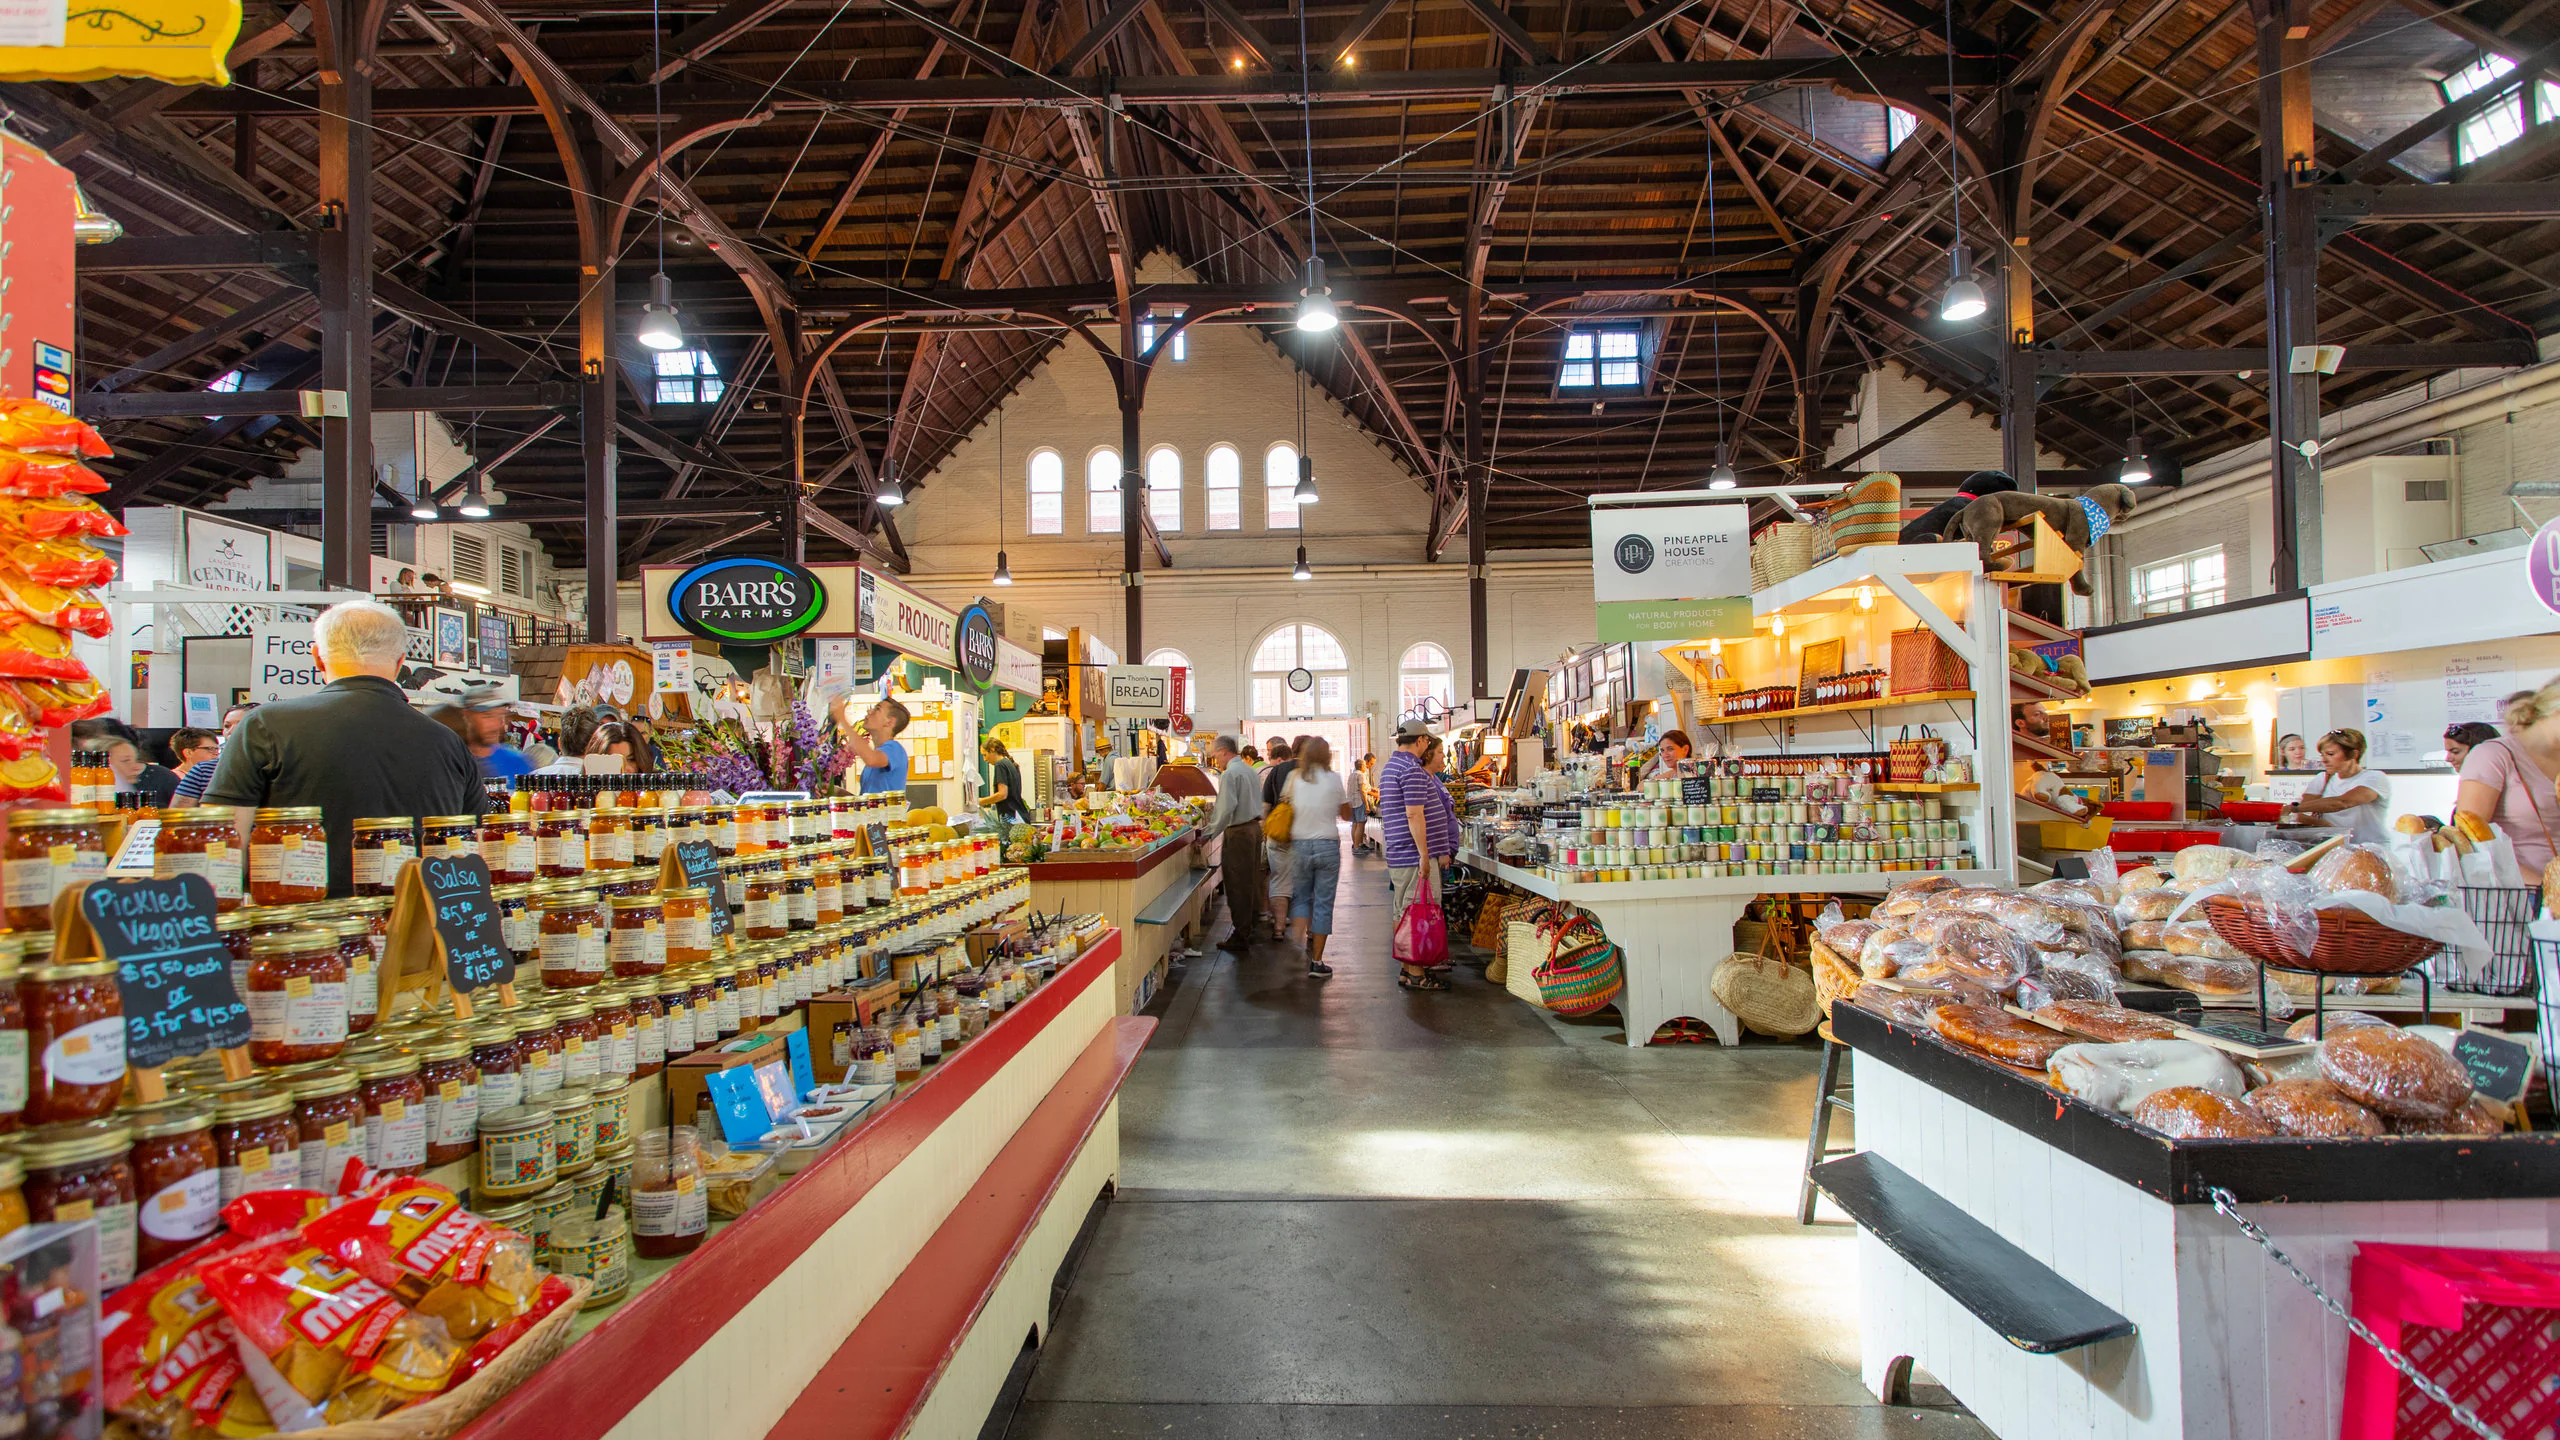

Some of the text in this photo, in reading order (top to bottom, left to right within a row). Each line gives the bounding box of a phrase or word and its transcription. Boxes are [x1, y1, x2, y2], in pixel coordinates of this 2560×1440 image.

[1664, 534, 1728, 545] PINEAPPLE
[1664, 547, 1705, 557] HOUSE
[208, 557, 252, 569] LANCASTER
[1665, 558, 1715, 567] CREATIONS
[193, 567, 262, 591] CENTRAL
[1628, 612, 1671, 620] NATURAL
[1674, 609, 1723, 618] PRODUCTS
[898, 601, 950, 651] PRODUCE
[1653, 621, 1678, 630] BODY
[1689, 620, 1715, 628] HOME
[1116, 686, 1160, 698] BREAD
[679, 845, 709, 860] No Sugar
[430, 861, 481, 889] Salsa
[90, 881, 195, 917] Pickled
[119, 915, 212, 951] Veggies
[451, 948, 462, 964] 3
[184, 957, 222, 977] each
[129, 1016, 150, 1041] 3
[151, 1011, 187, 1036] for
